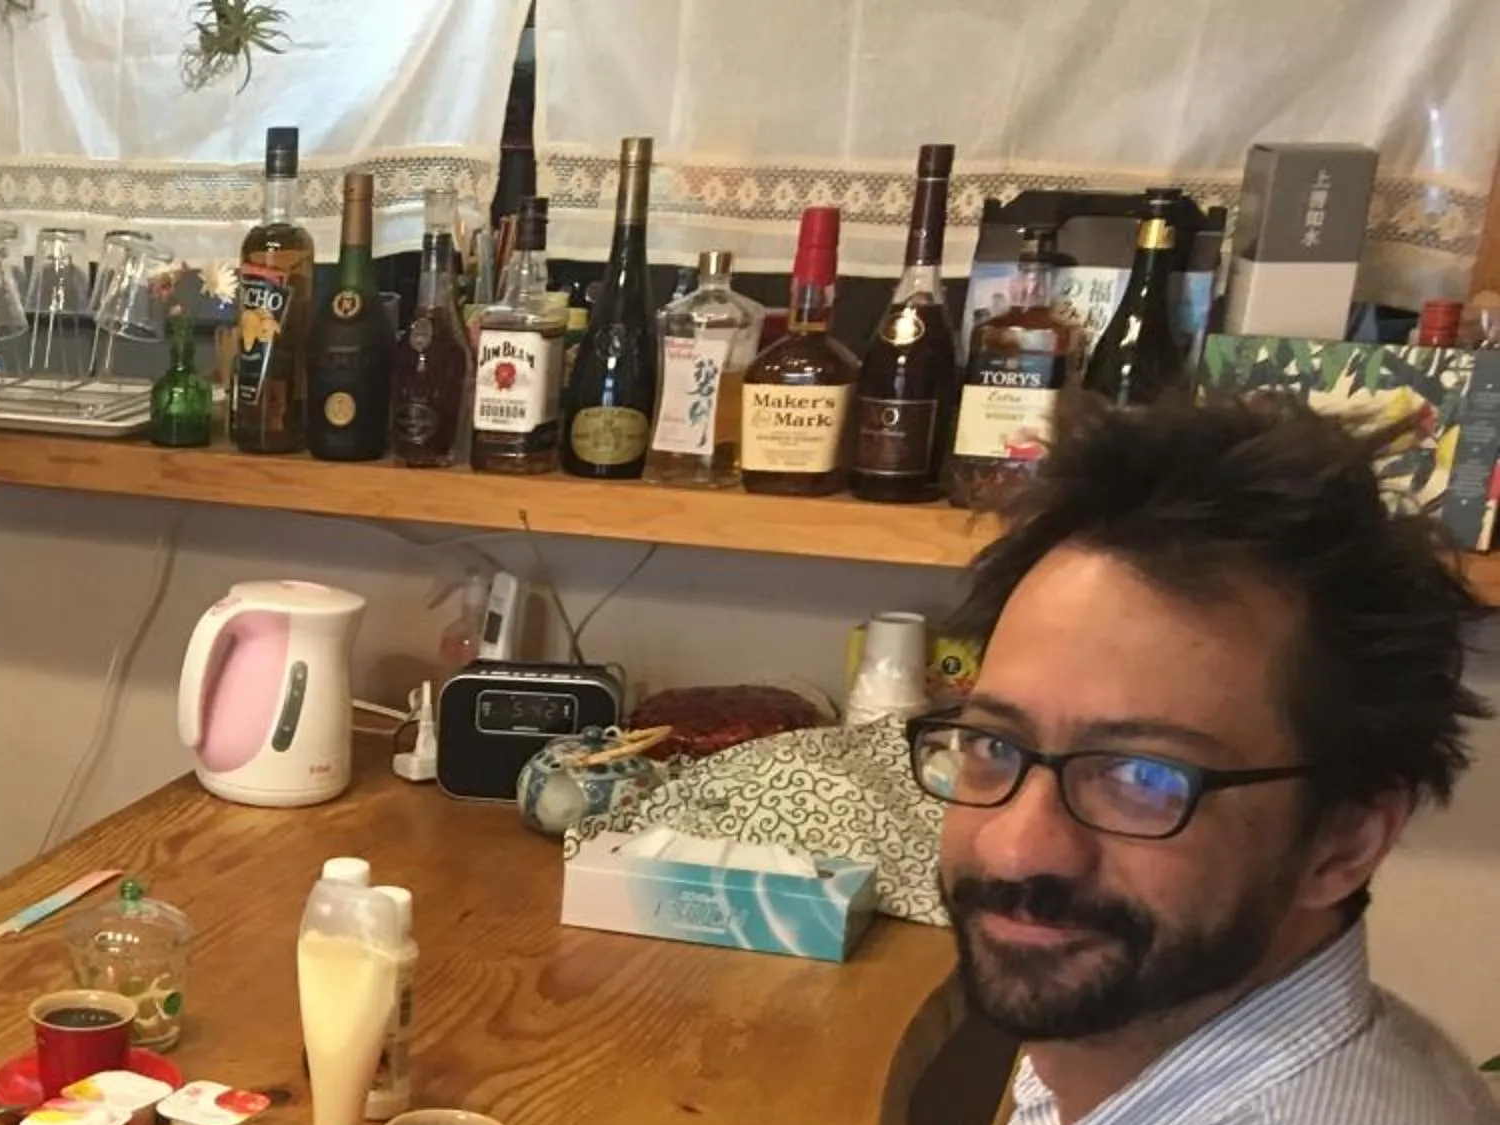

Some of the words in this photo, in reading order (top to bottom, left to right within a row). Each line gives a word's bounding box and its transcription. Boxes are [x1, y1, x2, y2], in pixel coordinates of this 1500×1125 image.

[479, 345, 501, 368] JIM
[502, 341, 535, 368] BEAM
[980, 370, 1042, 386] TORYS
[753, 393, 835, 409] Maker's
[773, 412, 833, 427] Mark
